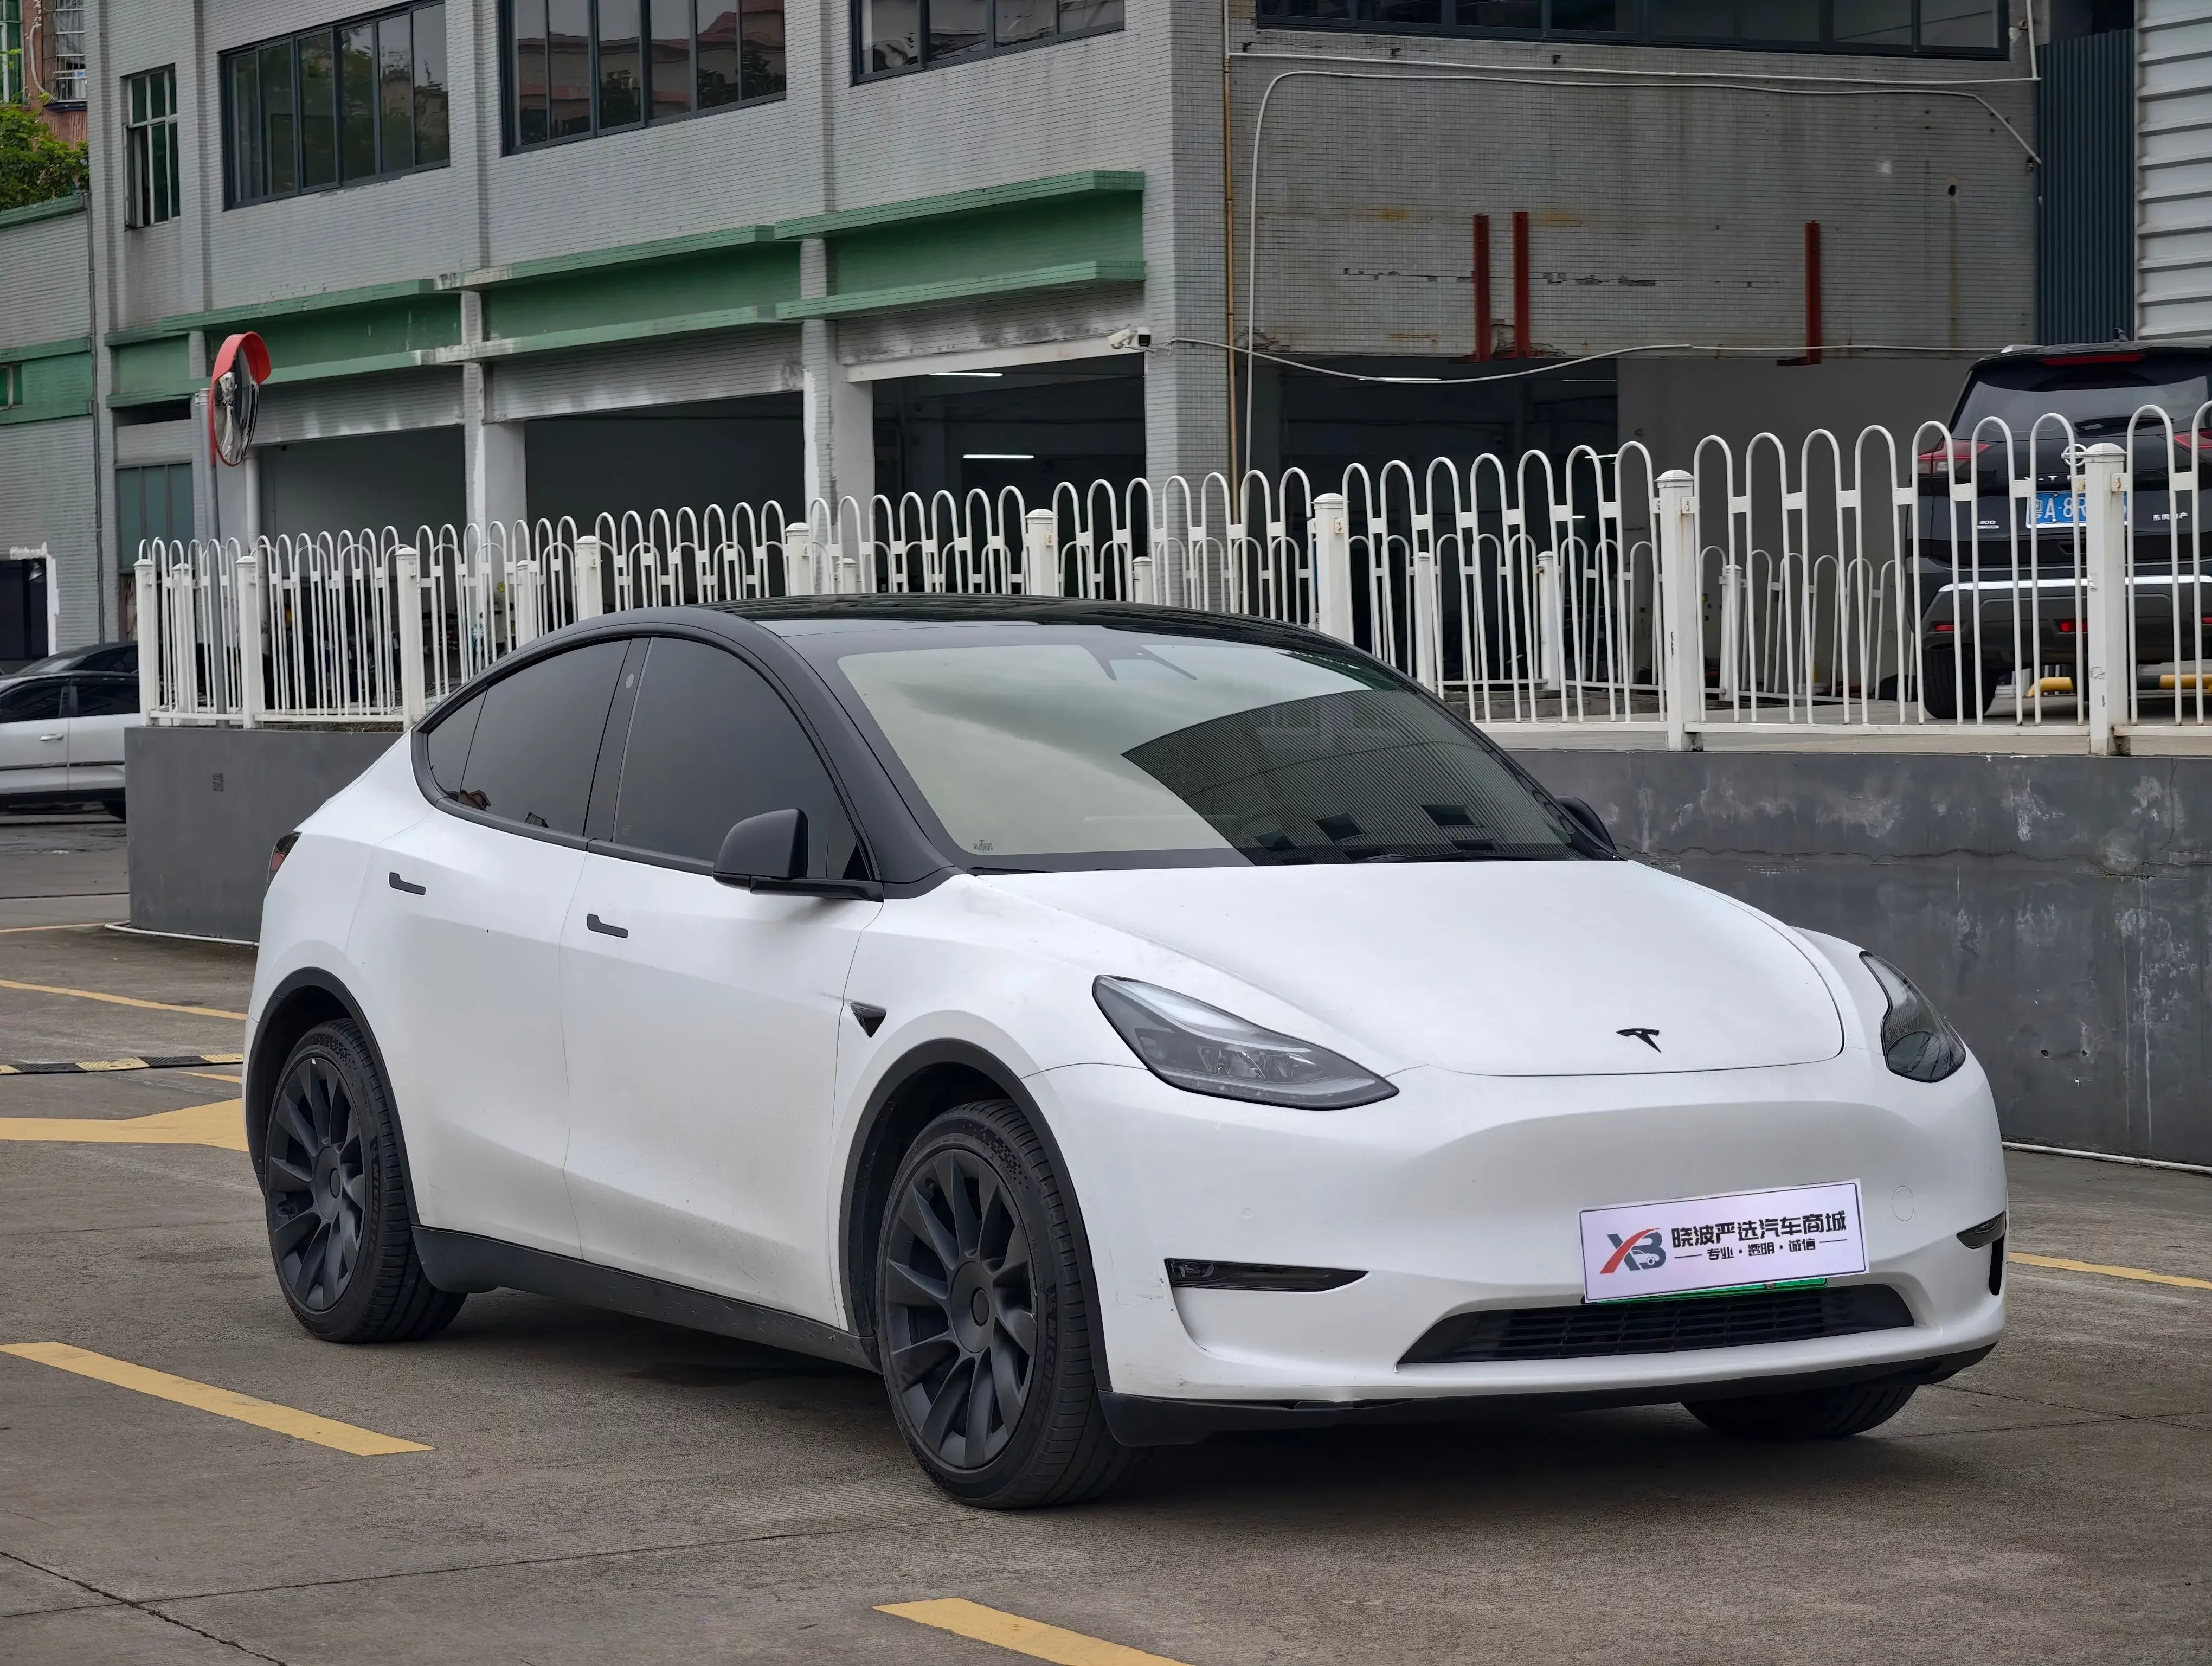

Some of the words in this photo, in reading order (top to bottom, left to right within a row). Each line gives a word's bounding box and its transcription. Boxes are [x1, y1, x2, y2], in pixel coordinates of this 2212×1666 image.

[368, 1163, 380, 1253] MICHELIN
[1671, 1210, 1847, 1248] 晓波严选汽车商城
[1032, 1317, 1057, 1429] MICHELIN
